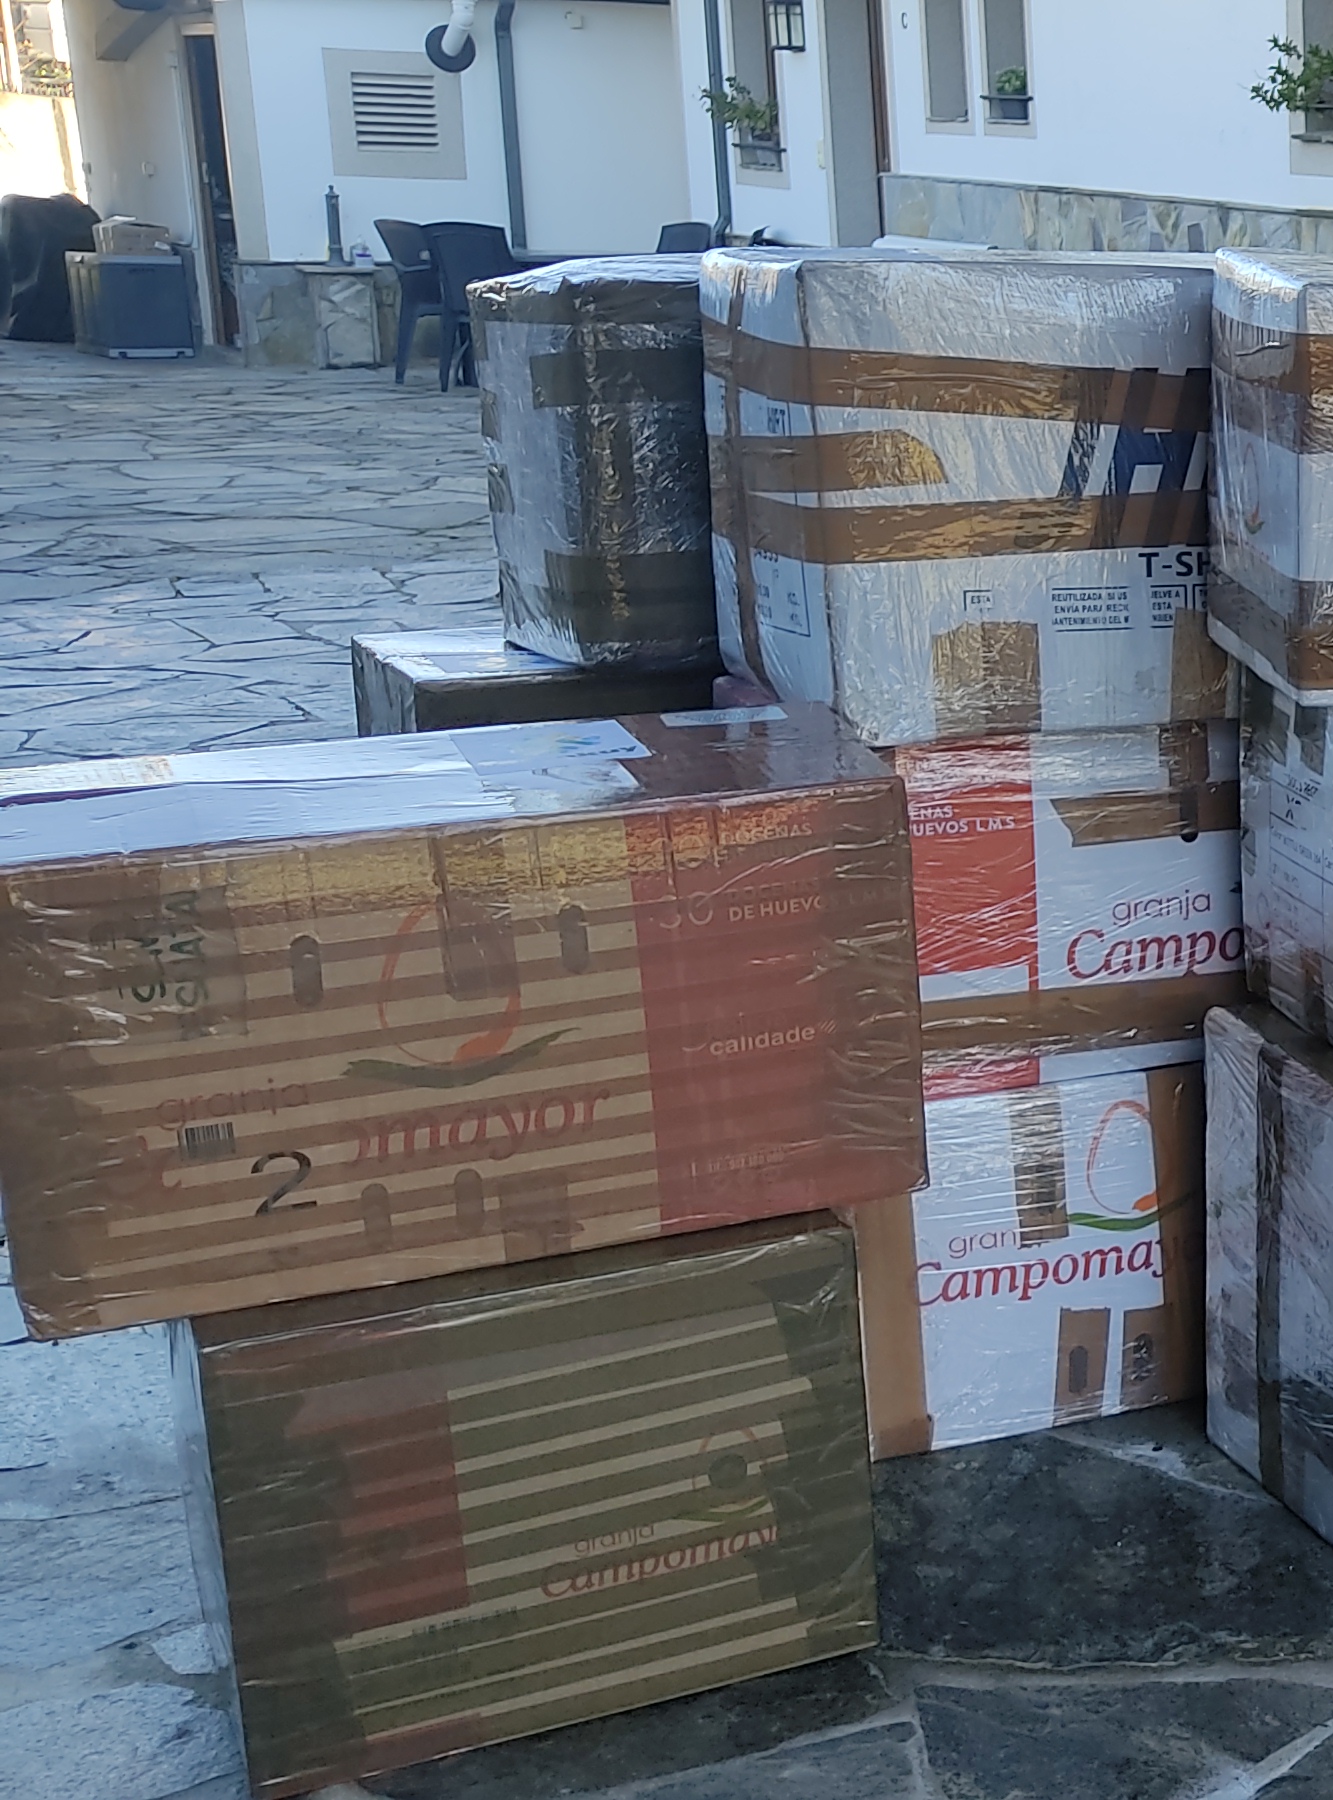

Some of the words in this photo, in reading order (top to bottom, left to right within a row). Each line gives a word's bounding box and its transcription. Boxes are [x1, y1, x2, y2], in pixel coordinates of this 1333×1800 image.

[911, 819, 968, 837] UEVOS
[1112, 889, 1211, 928] granja
[709, 1025, 816, 1056] calidade
[250, 1150, 319, 1218] 2
